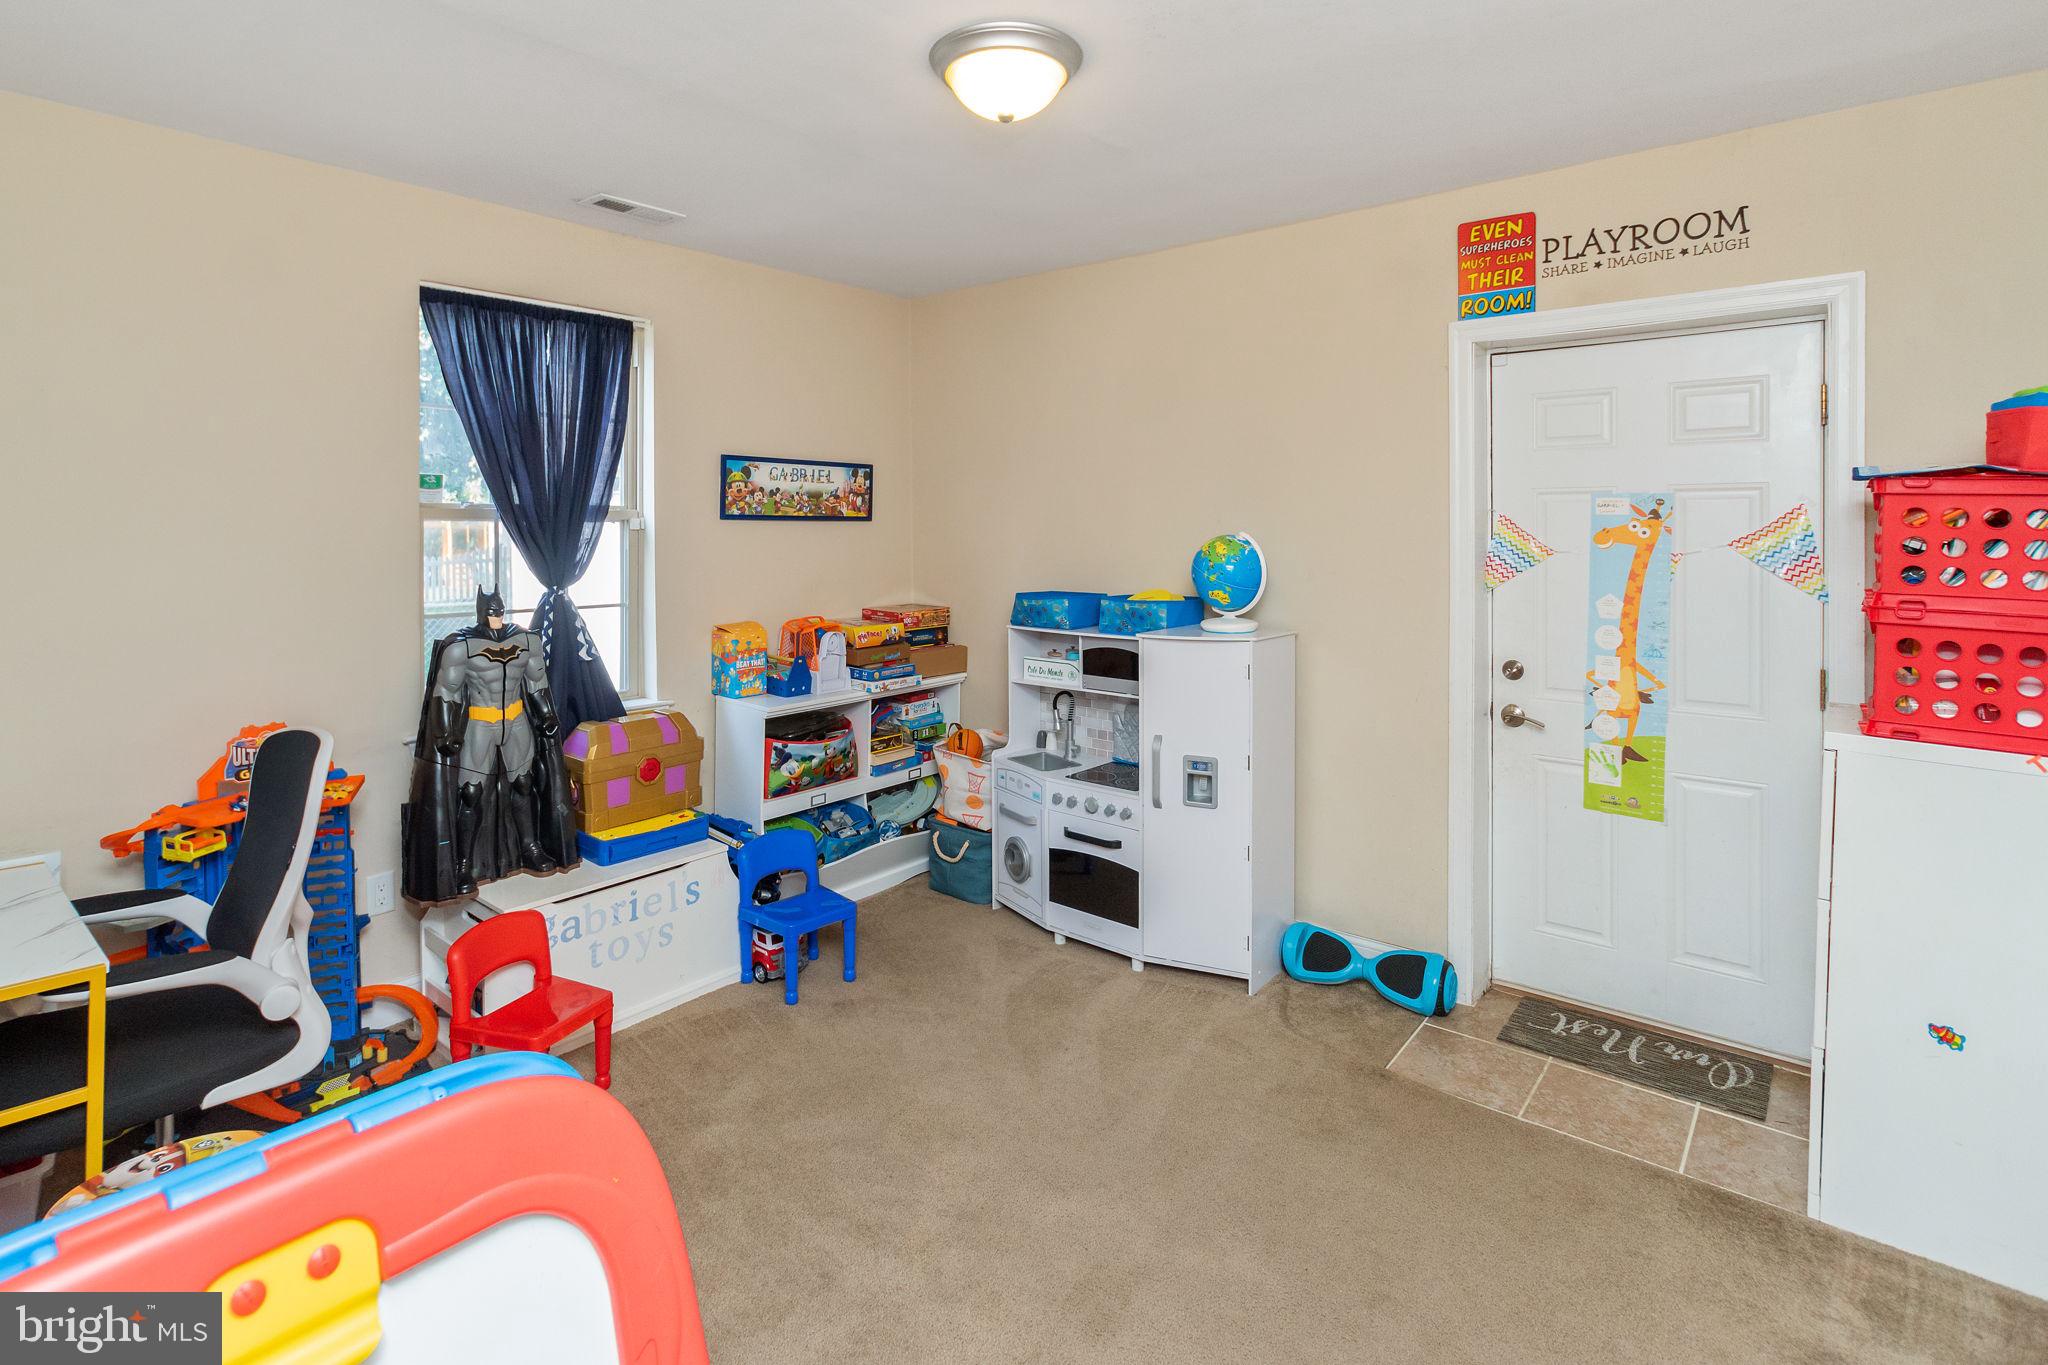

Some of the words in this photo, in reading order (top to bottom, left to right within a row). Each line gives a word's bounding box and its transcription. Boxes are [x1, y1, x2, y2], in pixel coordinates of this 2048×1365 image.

[1470, 218, 1524, 243] EVEN
[1542, 205, 1750, 264] PLAYROOM
[1460, 235, 1534, 257] SUPERHEROES
[1542, 261, 1589, 279] SHARE
[1606, 248, 1675, 270] IMAGINE
[1692, 237, 1750, 257] LAUGH
[1461, 257, 1492, 271] MUST
[1496, 251, 1534, 266] CLEAN
[1467, 266, 1525, 291] THEIR
[1460, 290, 1534, 319] ROOM!
[769, 466, 835, 484] GABRIEL
[232, 746, 259, 767] ULT
[588, 921, 674, 969] toys
[1526, 1011, 1647, 1065] Nest
[1654, 1040, 1754, 1090] Our
